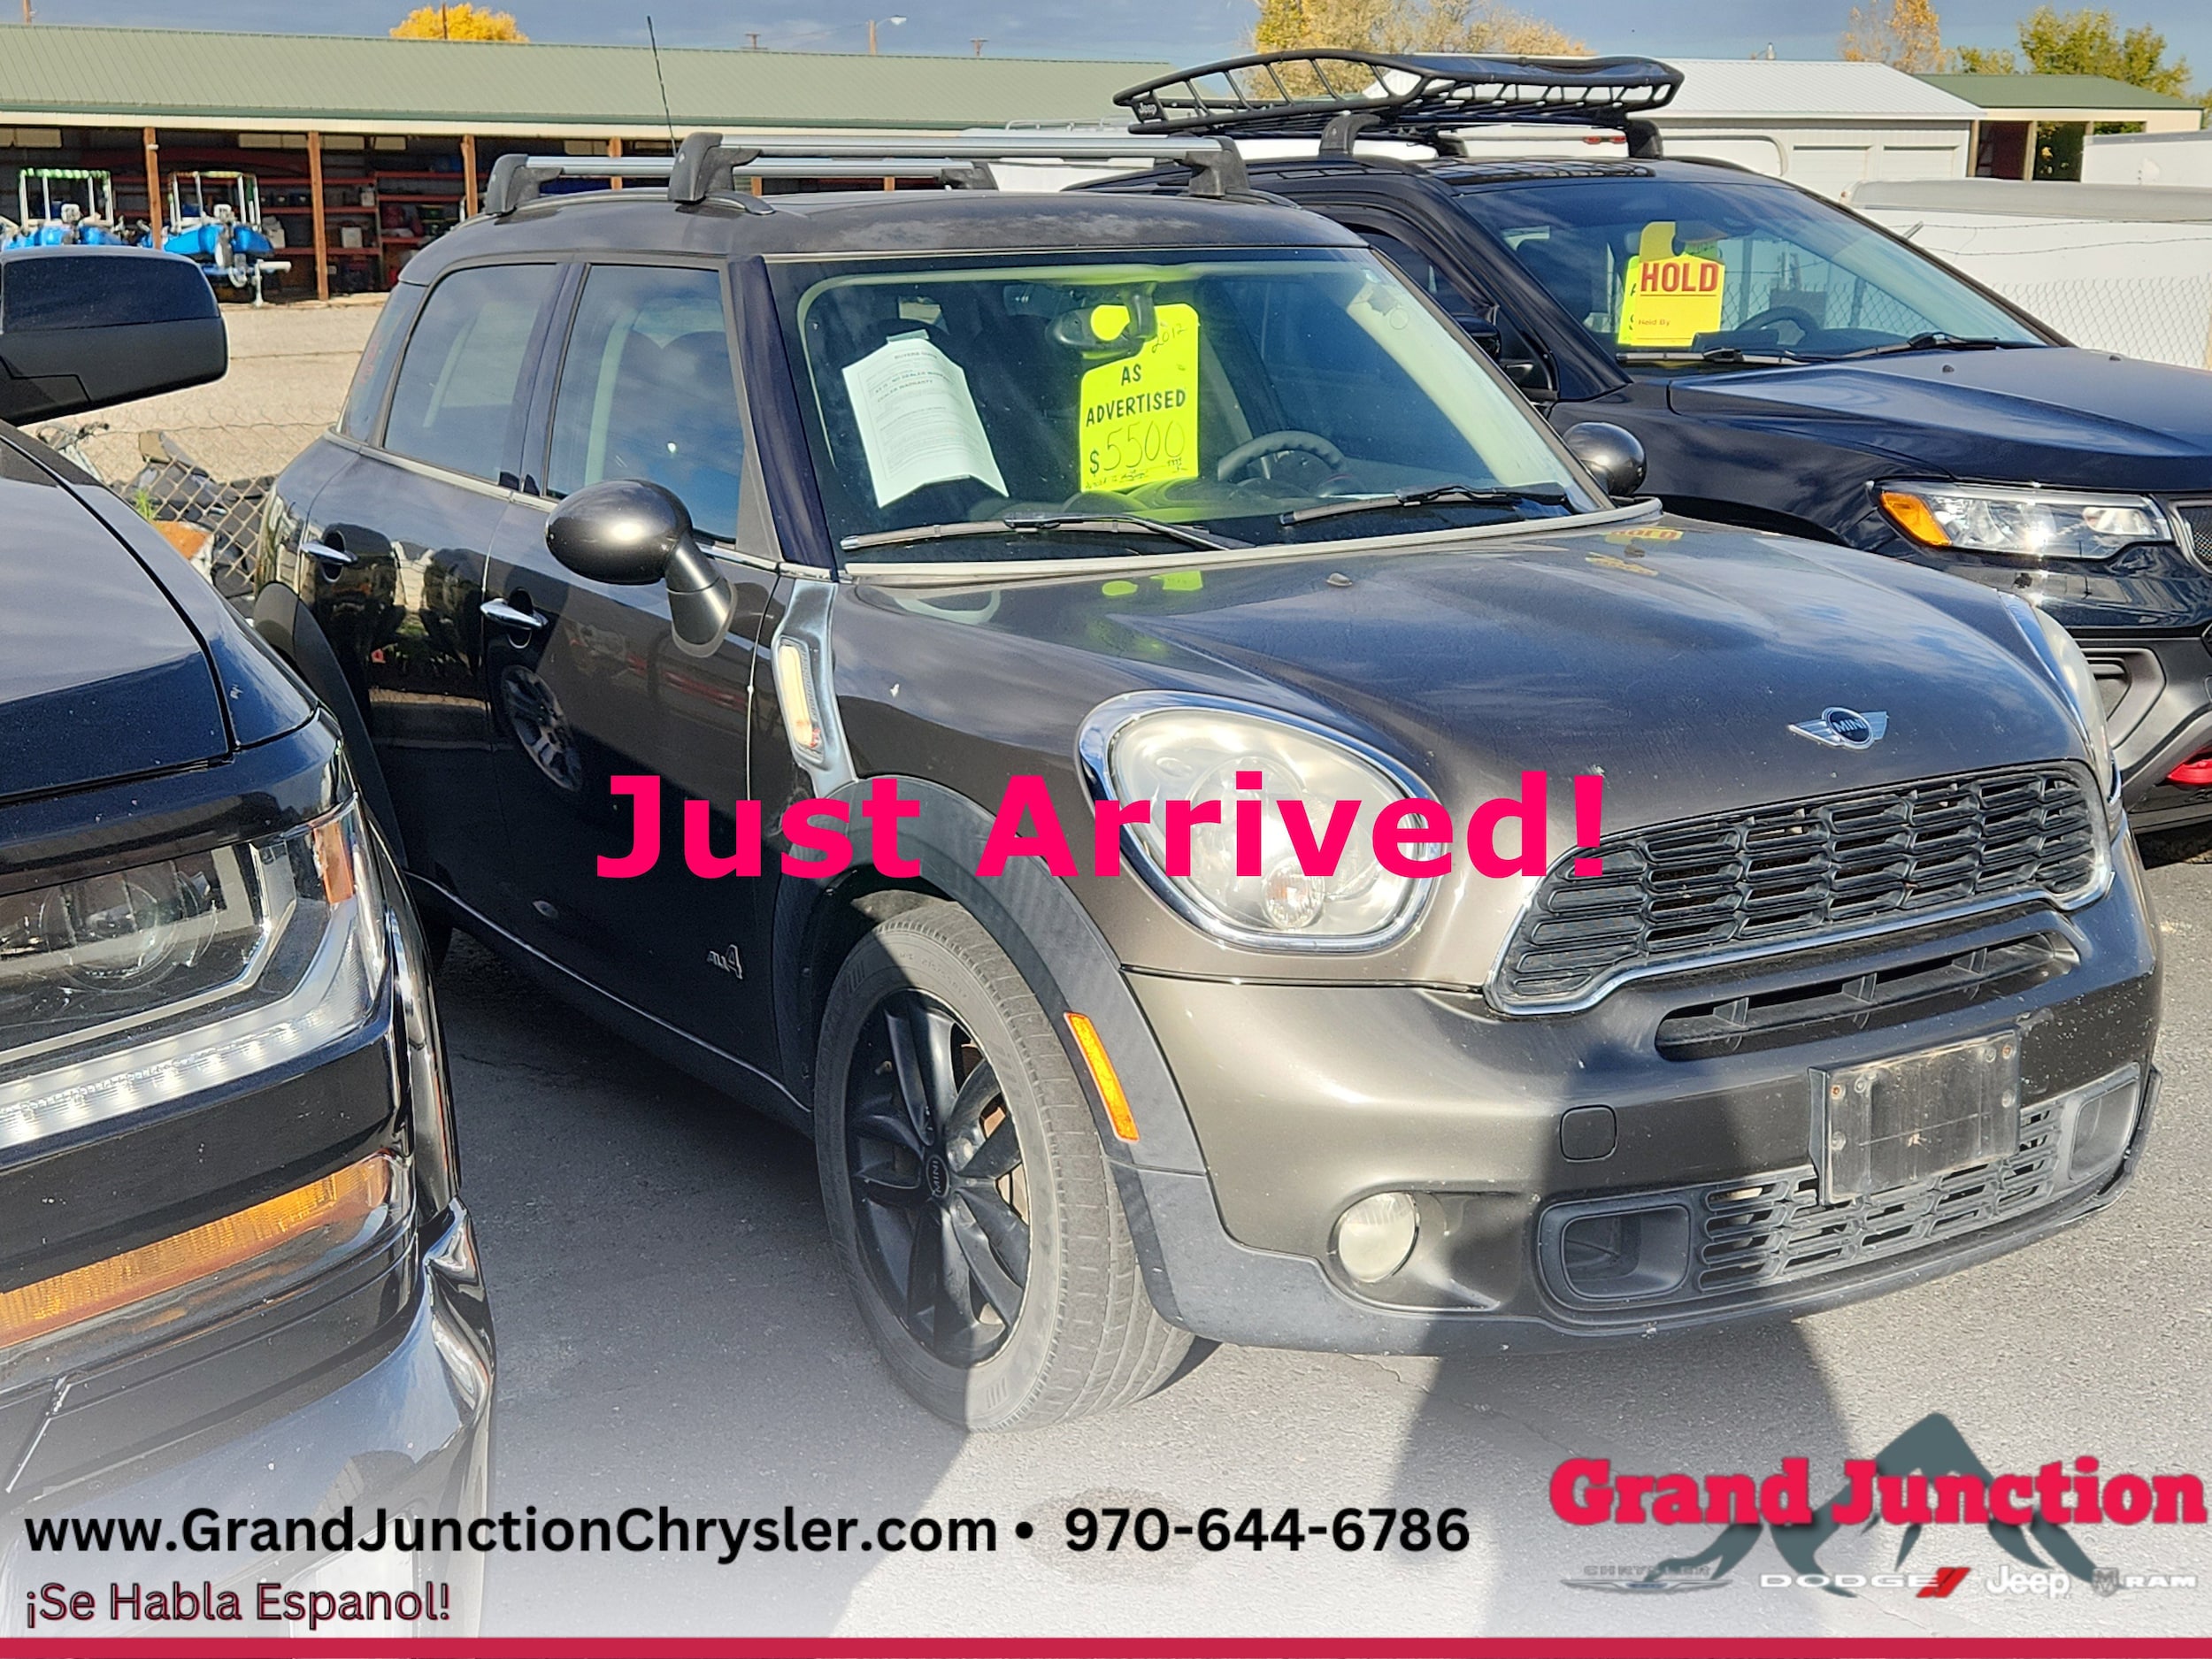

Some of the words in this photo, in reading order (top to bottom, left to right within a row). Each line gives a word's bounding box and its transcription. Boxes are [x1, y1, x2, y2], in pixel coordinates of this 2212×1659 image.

[1640, 262, 1720, 292] HOLD
[1152, 323, 1187, 354] 2012
[1121, 363, 1142, 386] AS
[1085, 388, 1187, 427] ADVERTISED
[1832, 718, 1868, 733] MINI
[932, 1160, 942, 1194] MINI
